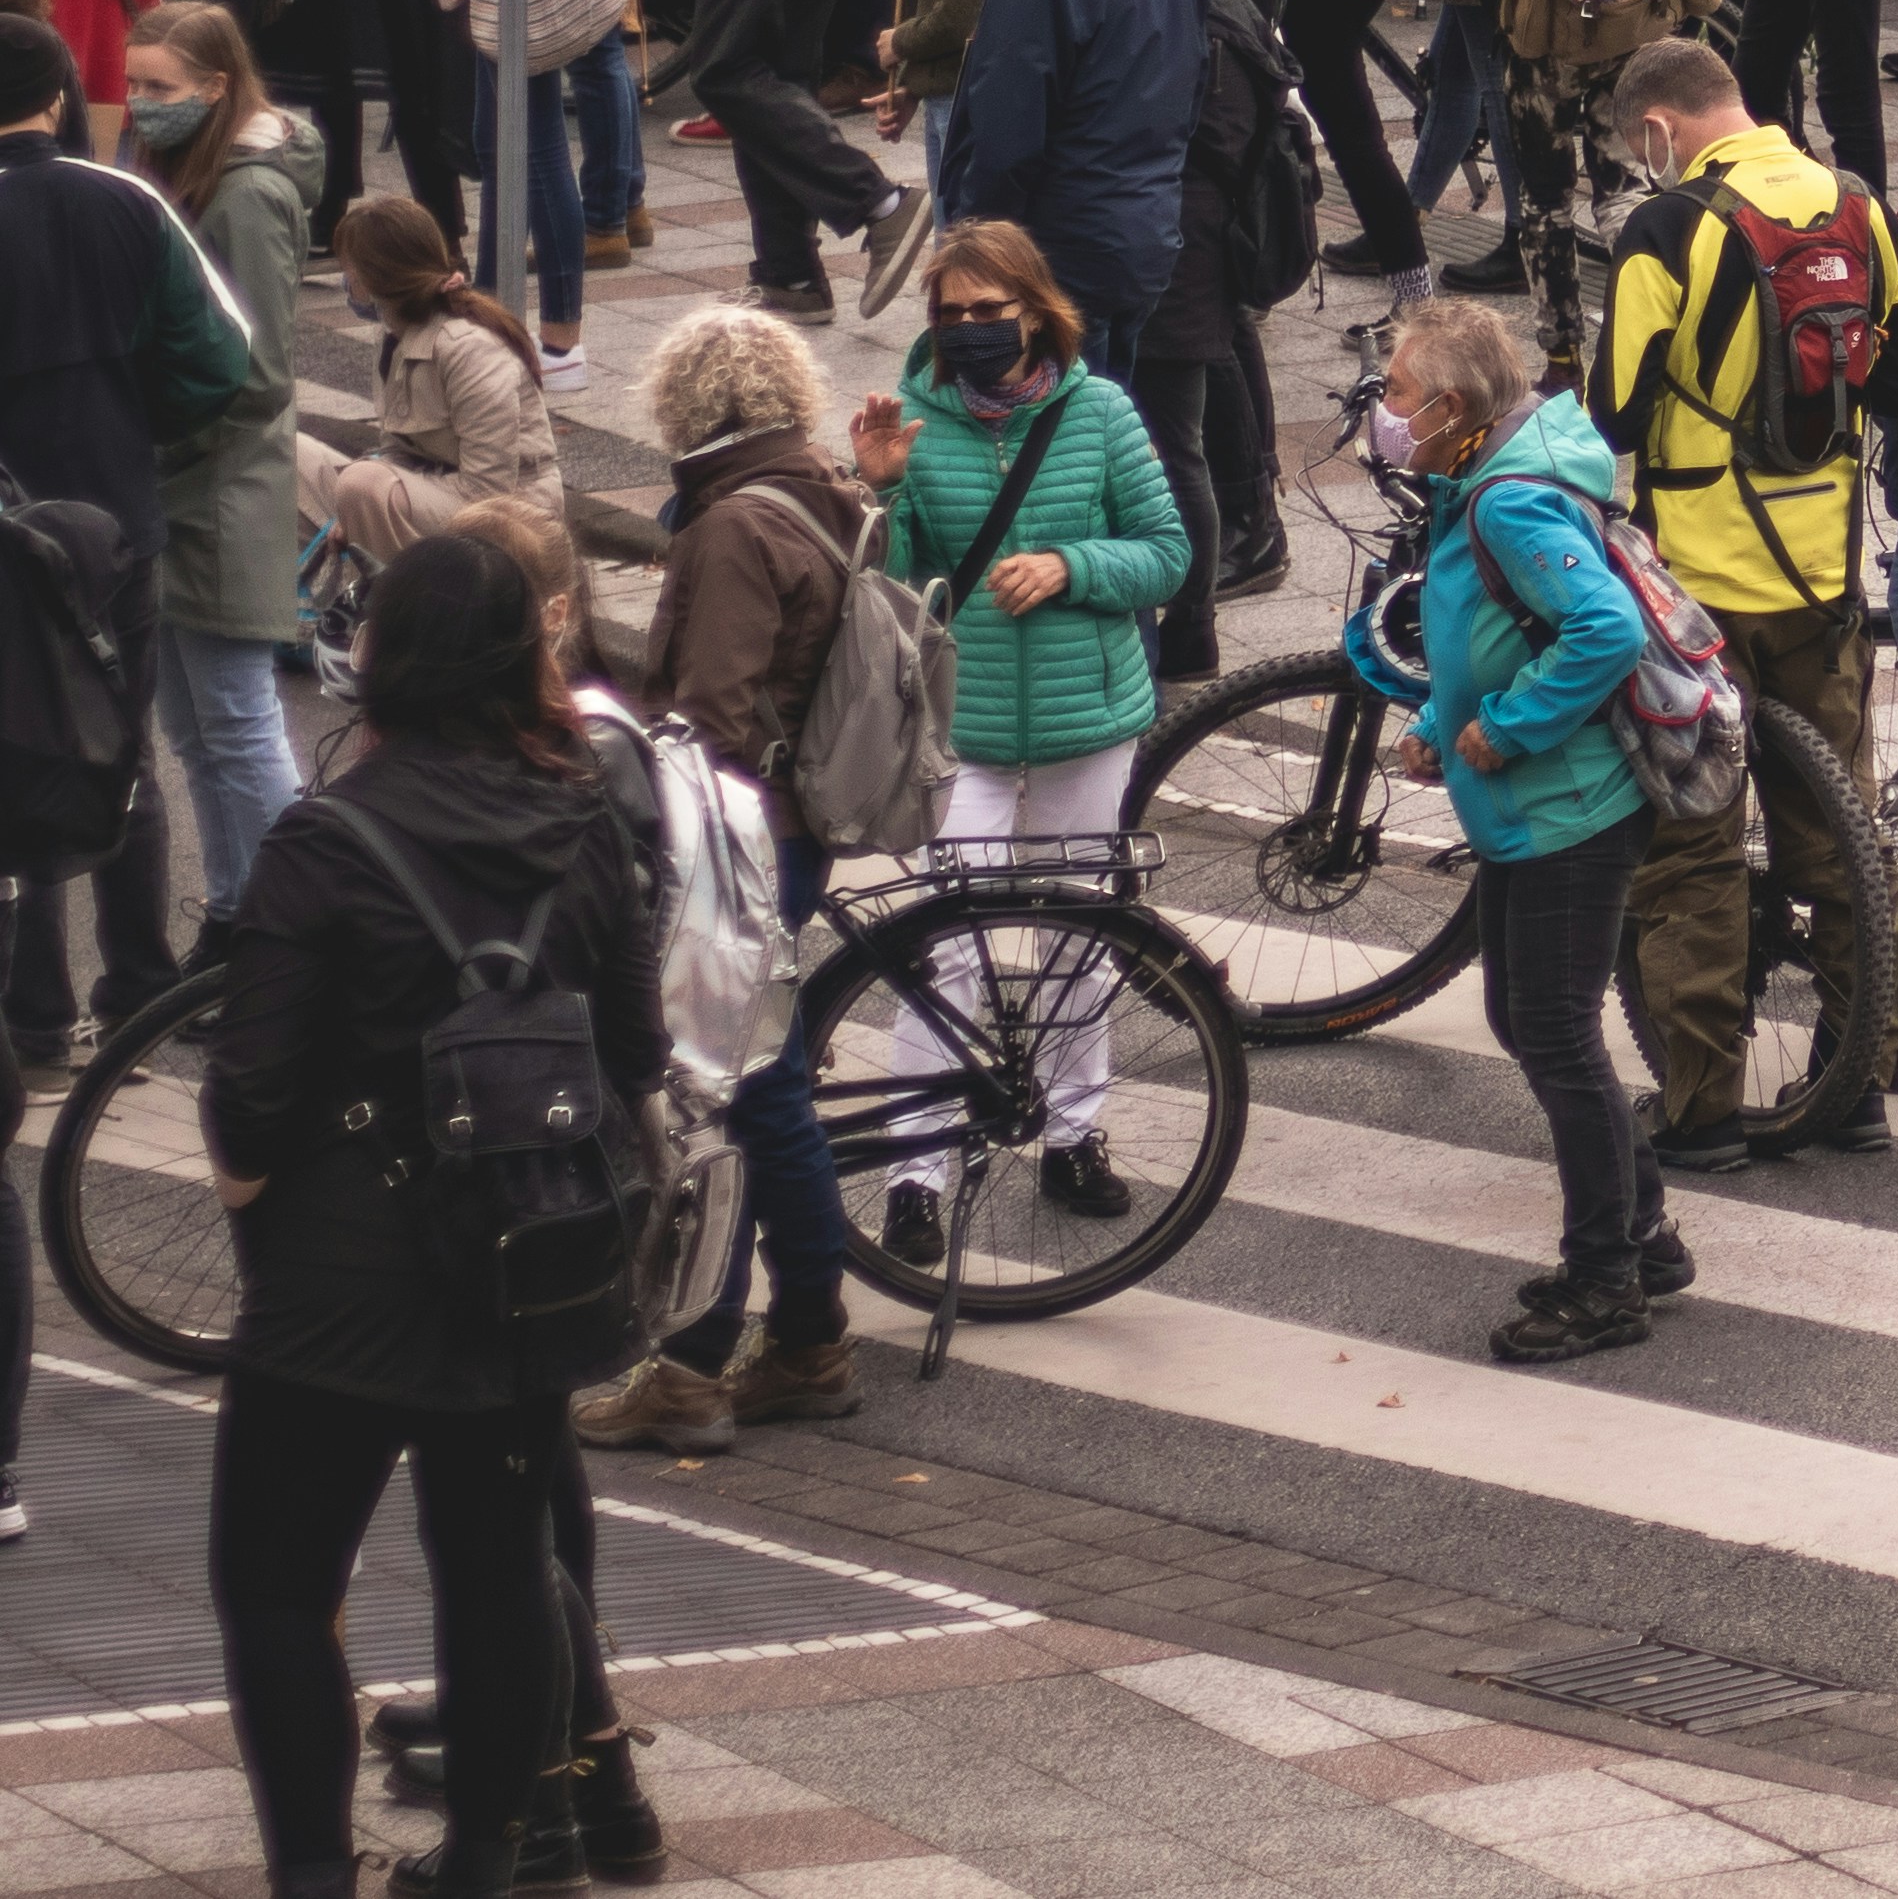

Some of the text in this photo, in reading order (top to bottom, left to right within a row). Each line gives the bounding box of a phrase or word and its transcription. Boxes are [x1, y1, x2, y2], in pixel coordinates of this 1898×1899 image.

[1818, 256, 1836, 266] THE
[1806, 265, 1836, 275] NORTH
[1816, 273, 1837, 282] FACE
